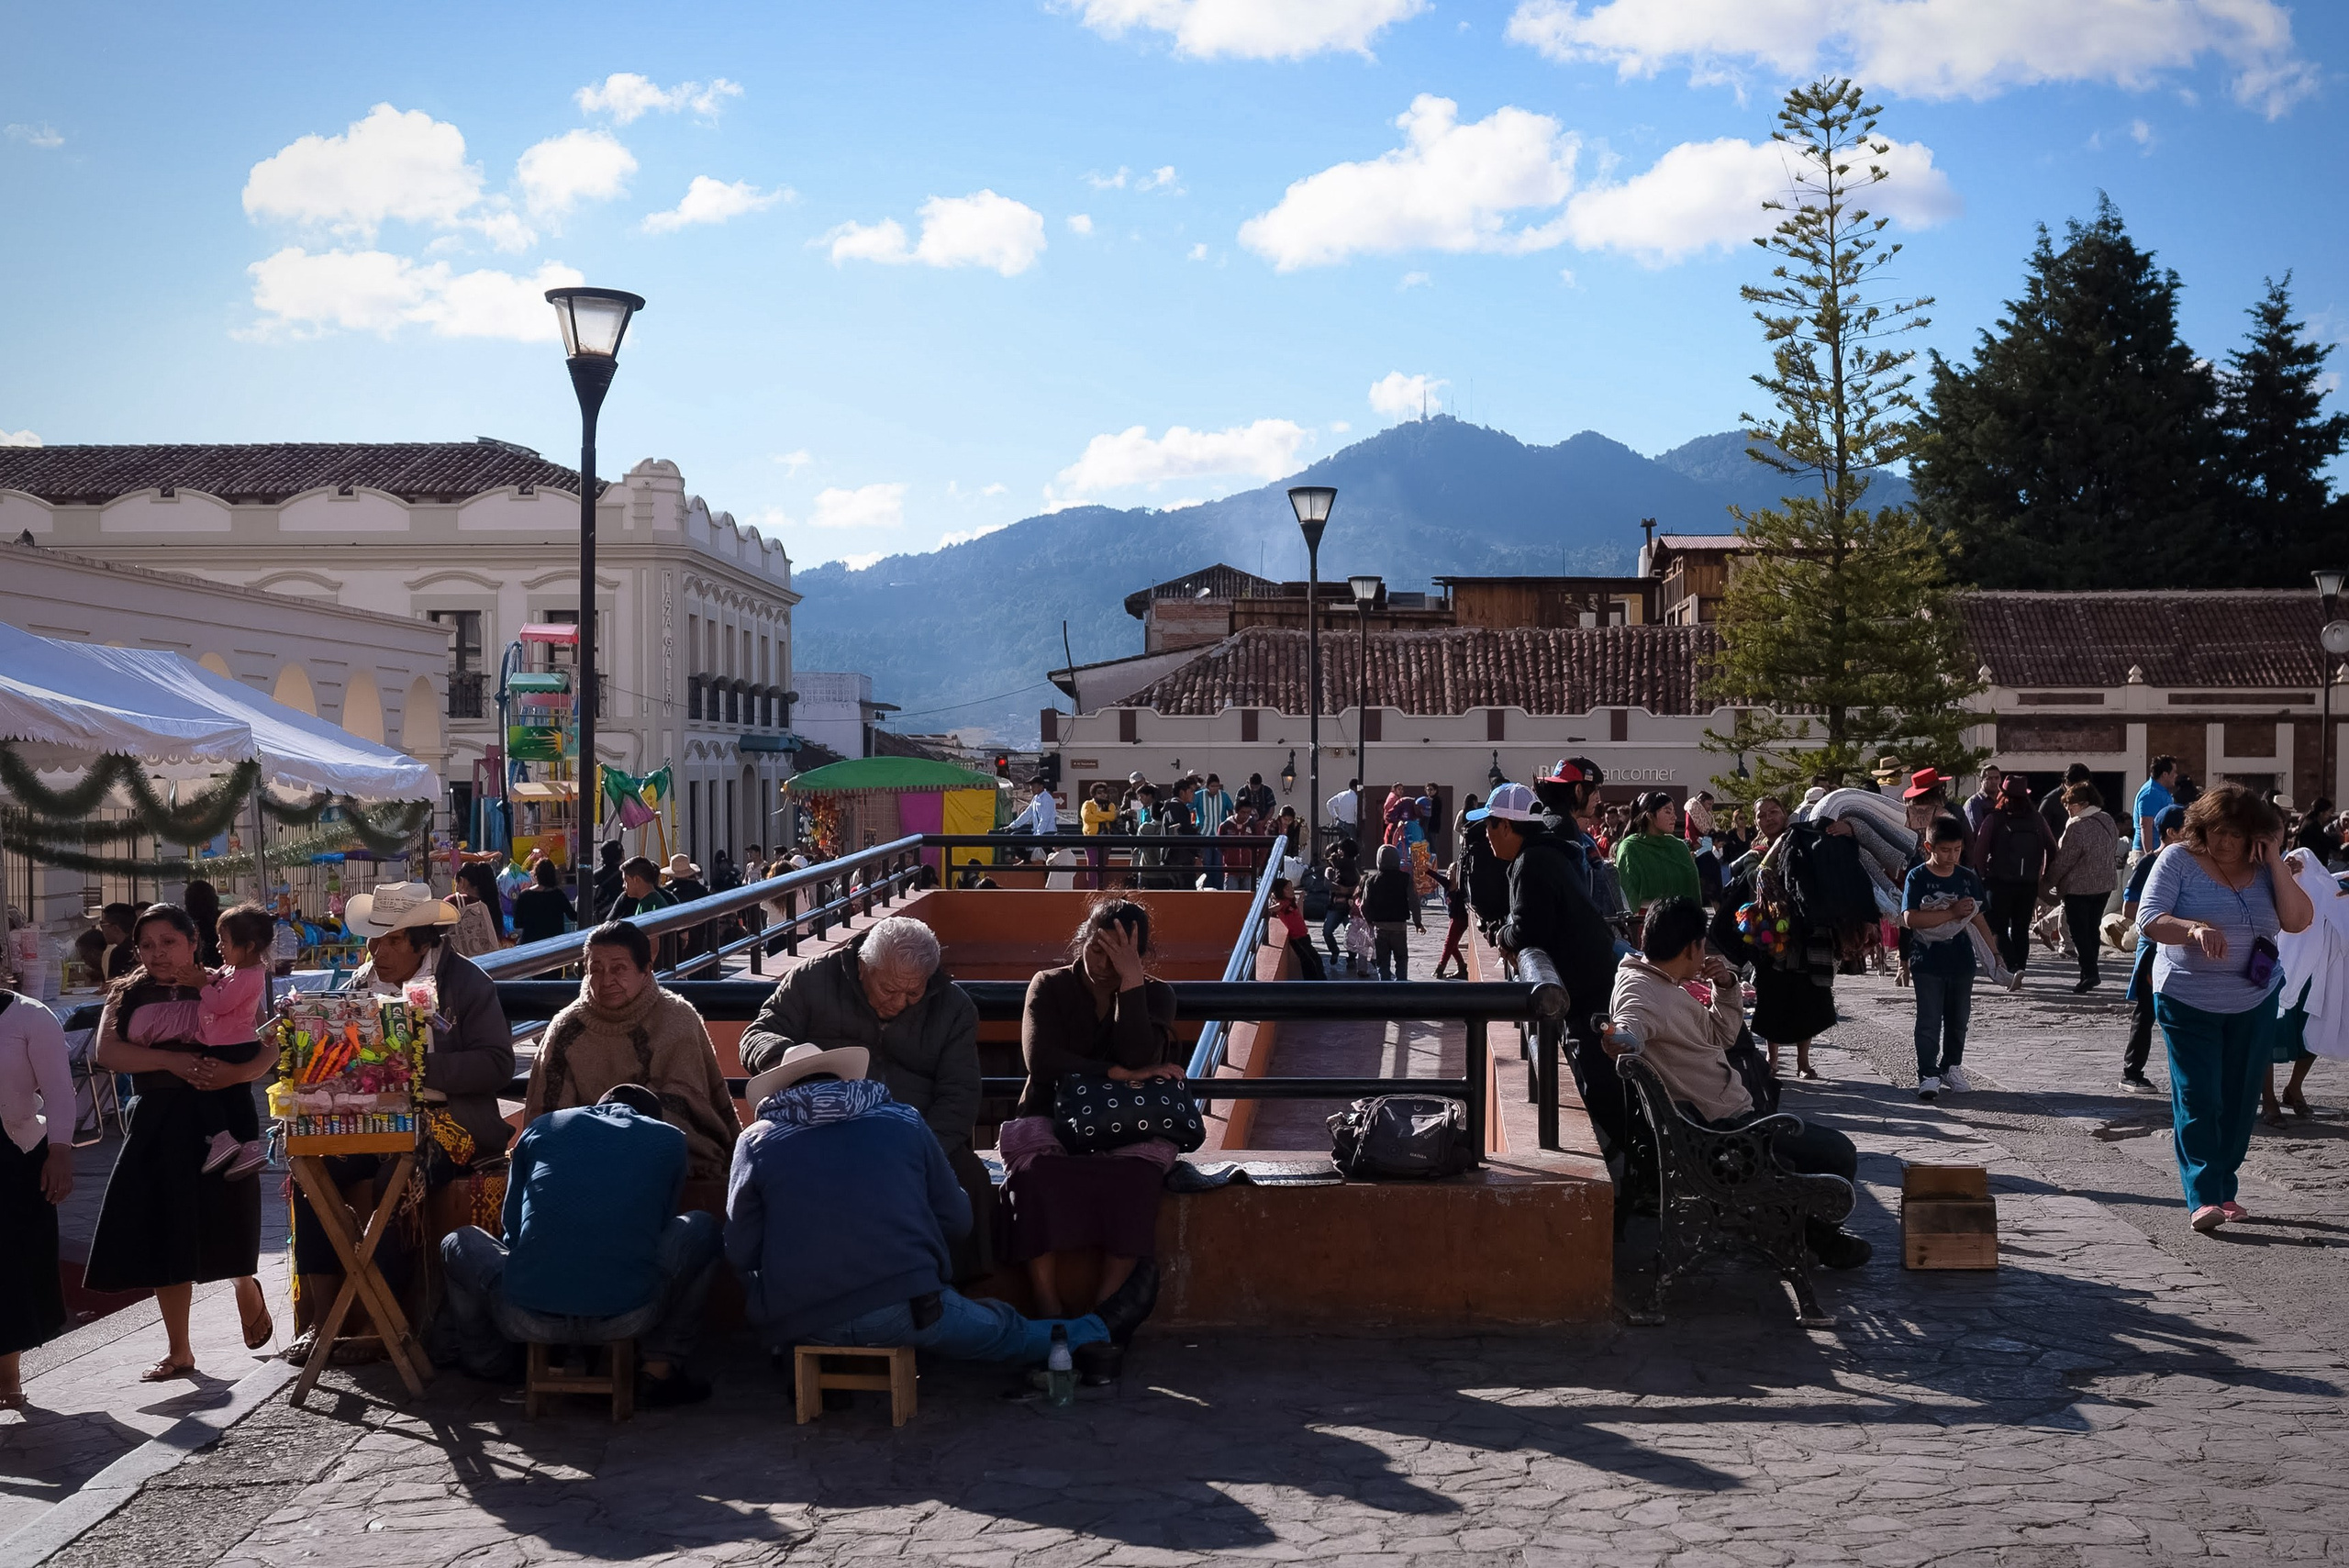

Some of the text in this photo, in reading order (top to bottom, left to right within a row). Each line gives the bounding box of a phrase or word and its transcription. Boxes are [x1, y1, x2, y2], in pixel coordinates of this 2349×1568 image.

[663, 571, 673, 713] PLAZA GALLERY
[1601, 767, 1676, 781] ancomer
